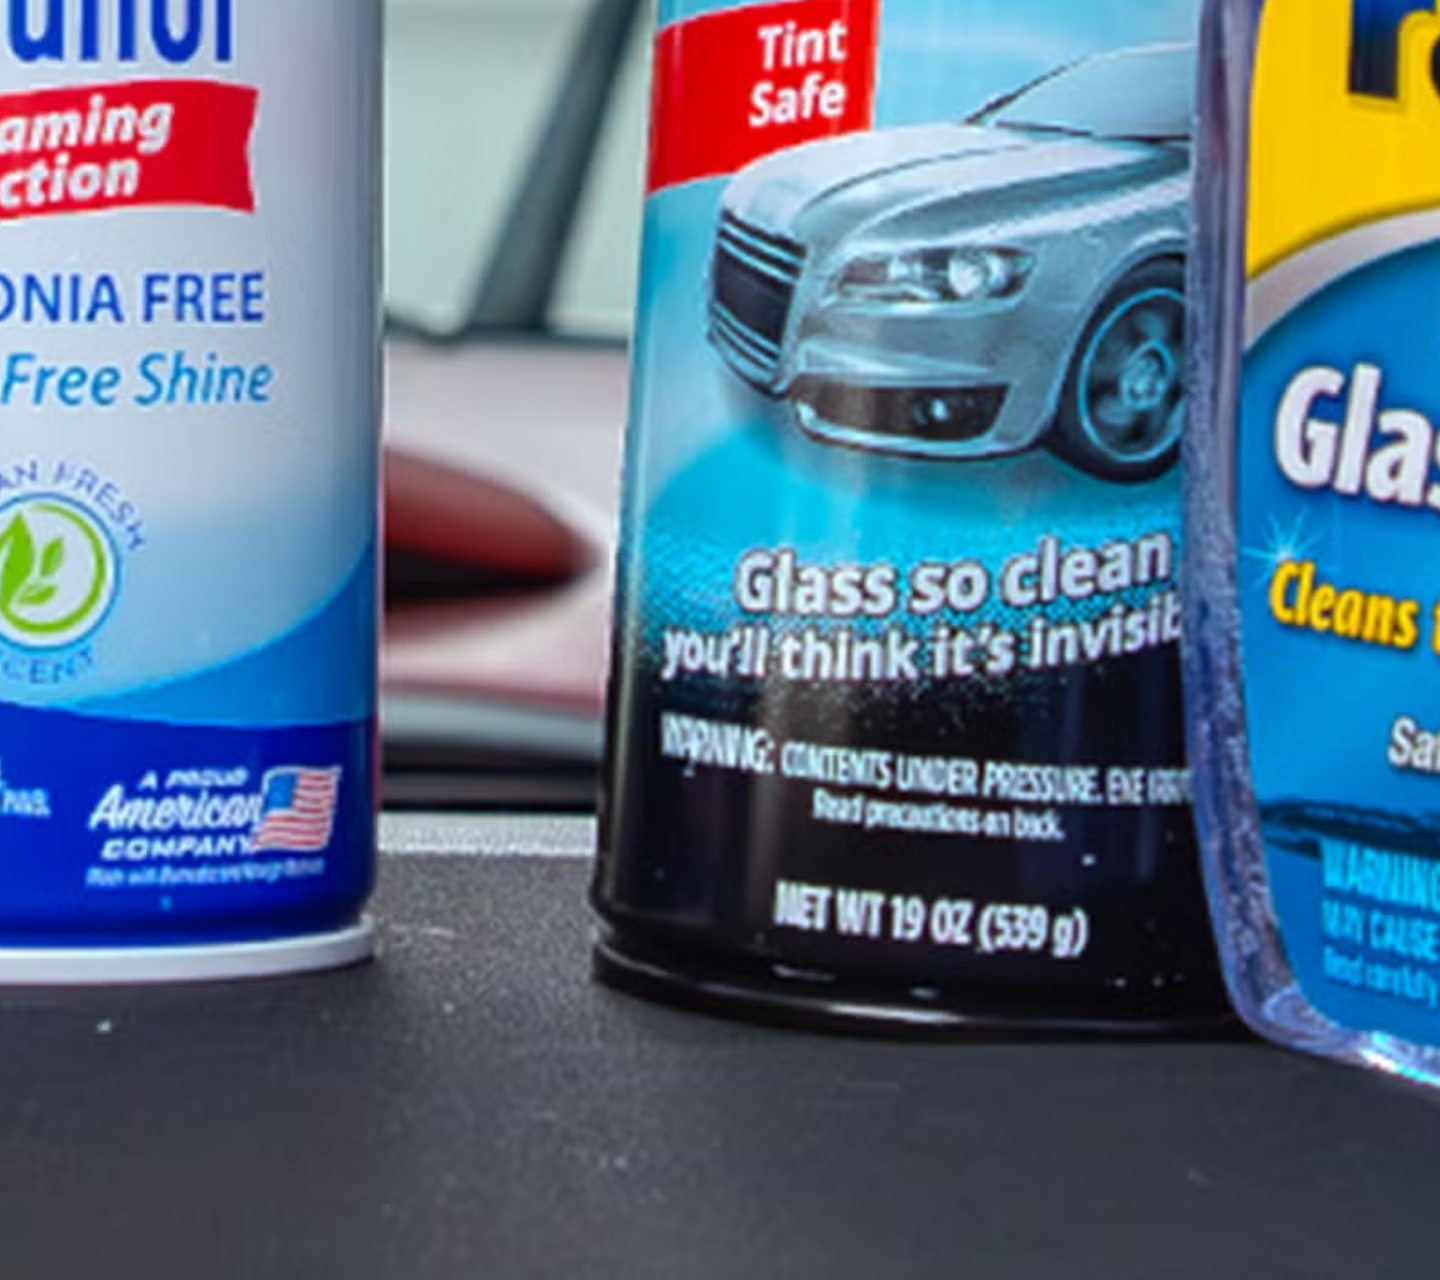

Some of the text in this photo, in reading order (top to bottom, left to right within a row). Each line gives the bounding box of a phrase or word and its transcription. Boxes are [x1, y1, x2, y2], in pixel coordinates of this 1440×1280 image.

[756, 18, 848, 70] Tint
[749, 74, 847, 128] Safe
[142, 271, 265, 323] FREE
[136, 351, 273, 406] Shine
[55, 460, 146, 551] FRESH
[735, 533, 1172, 615] Glass so clean
[1269, 559, 1418, 646] Cleans
[660, 624, 766, 682] you'll
[780, 627, 919, 682] think
[932, 621, 1014, 679] it's
[137, 770, 158, 791] A
[896, 753, 978, 796] UNDER
[87, 783, 264, 832] American
[100, 835, 255, 861] COMPANY
[774, 881, 831, 933] NET
[836, 888, 884, 937] WT
[891, 895, 926, 941] 19
[932, 899, 976, 945] OZ
[980, 901, 1048, 954] (539
[1370, 909, 1440, 963] CAUSE
